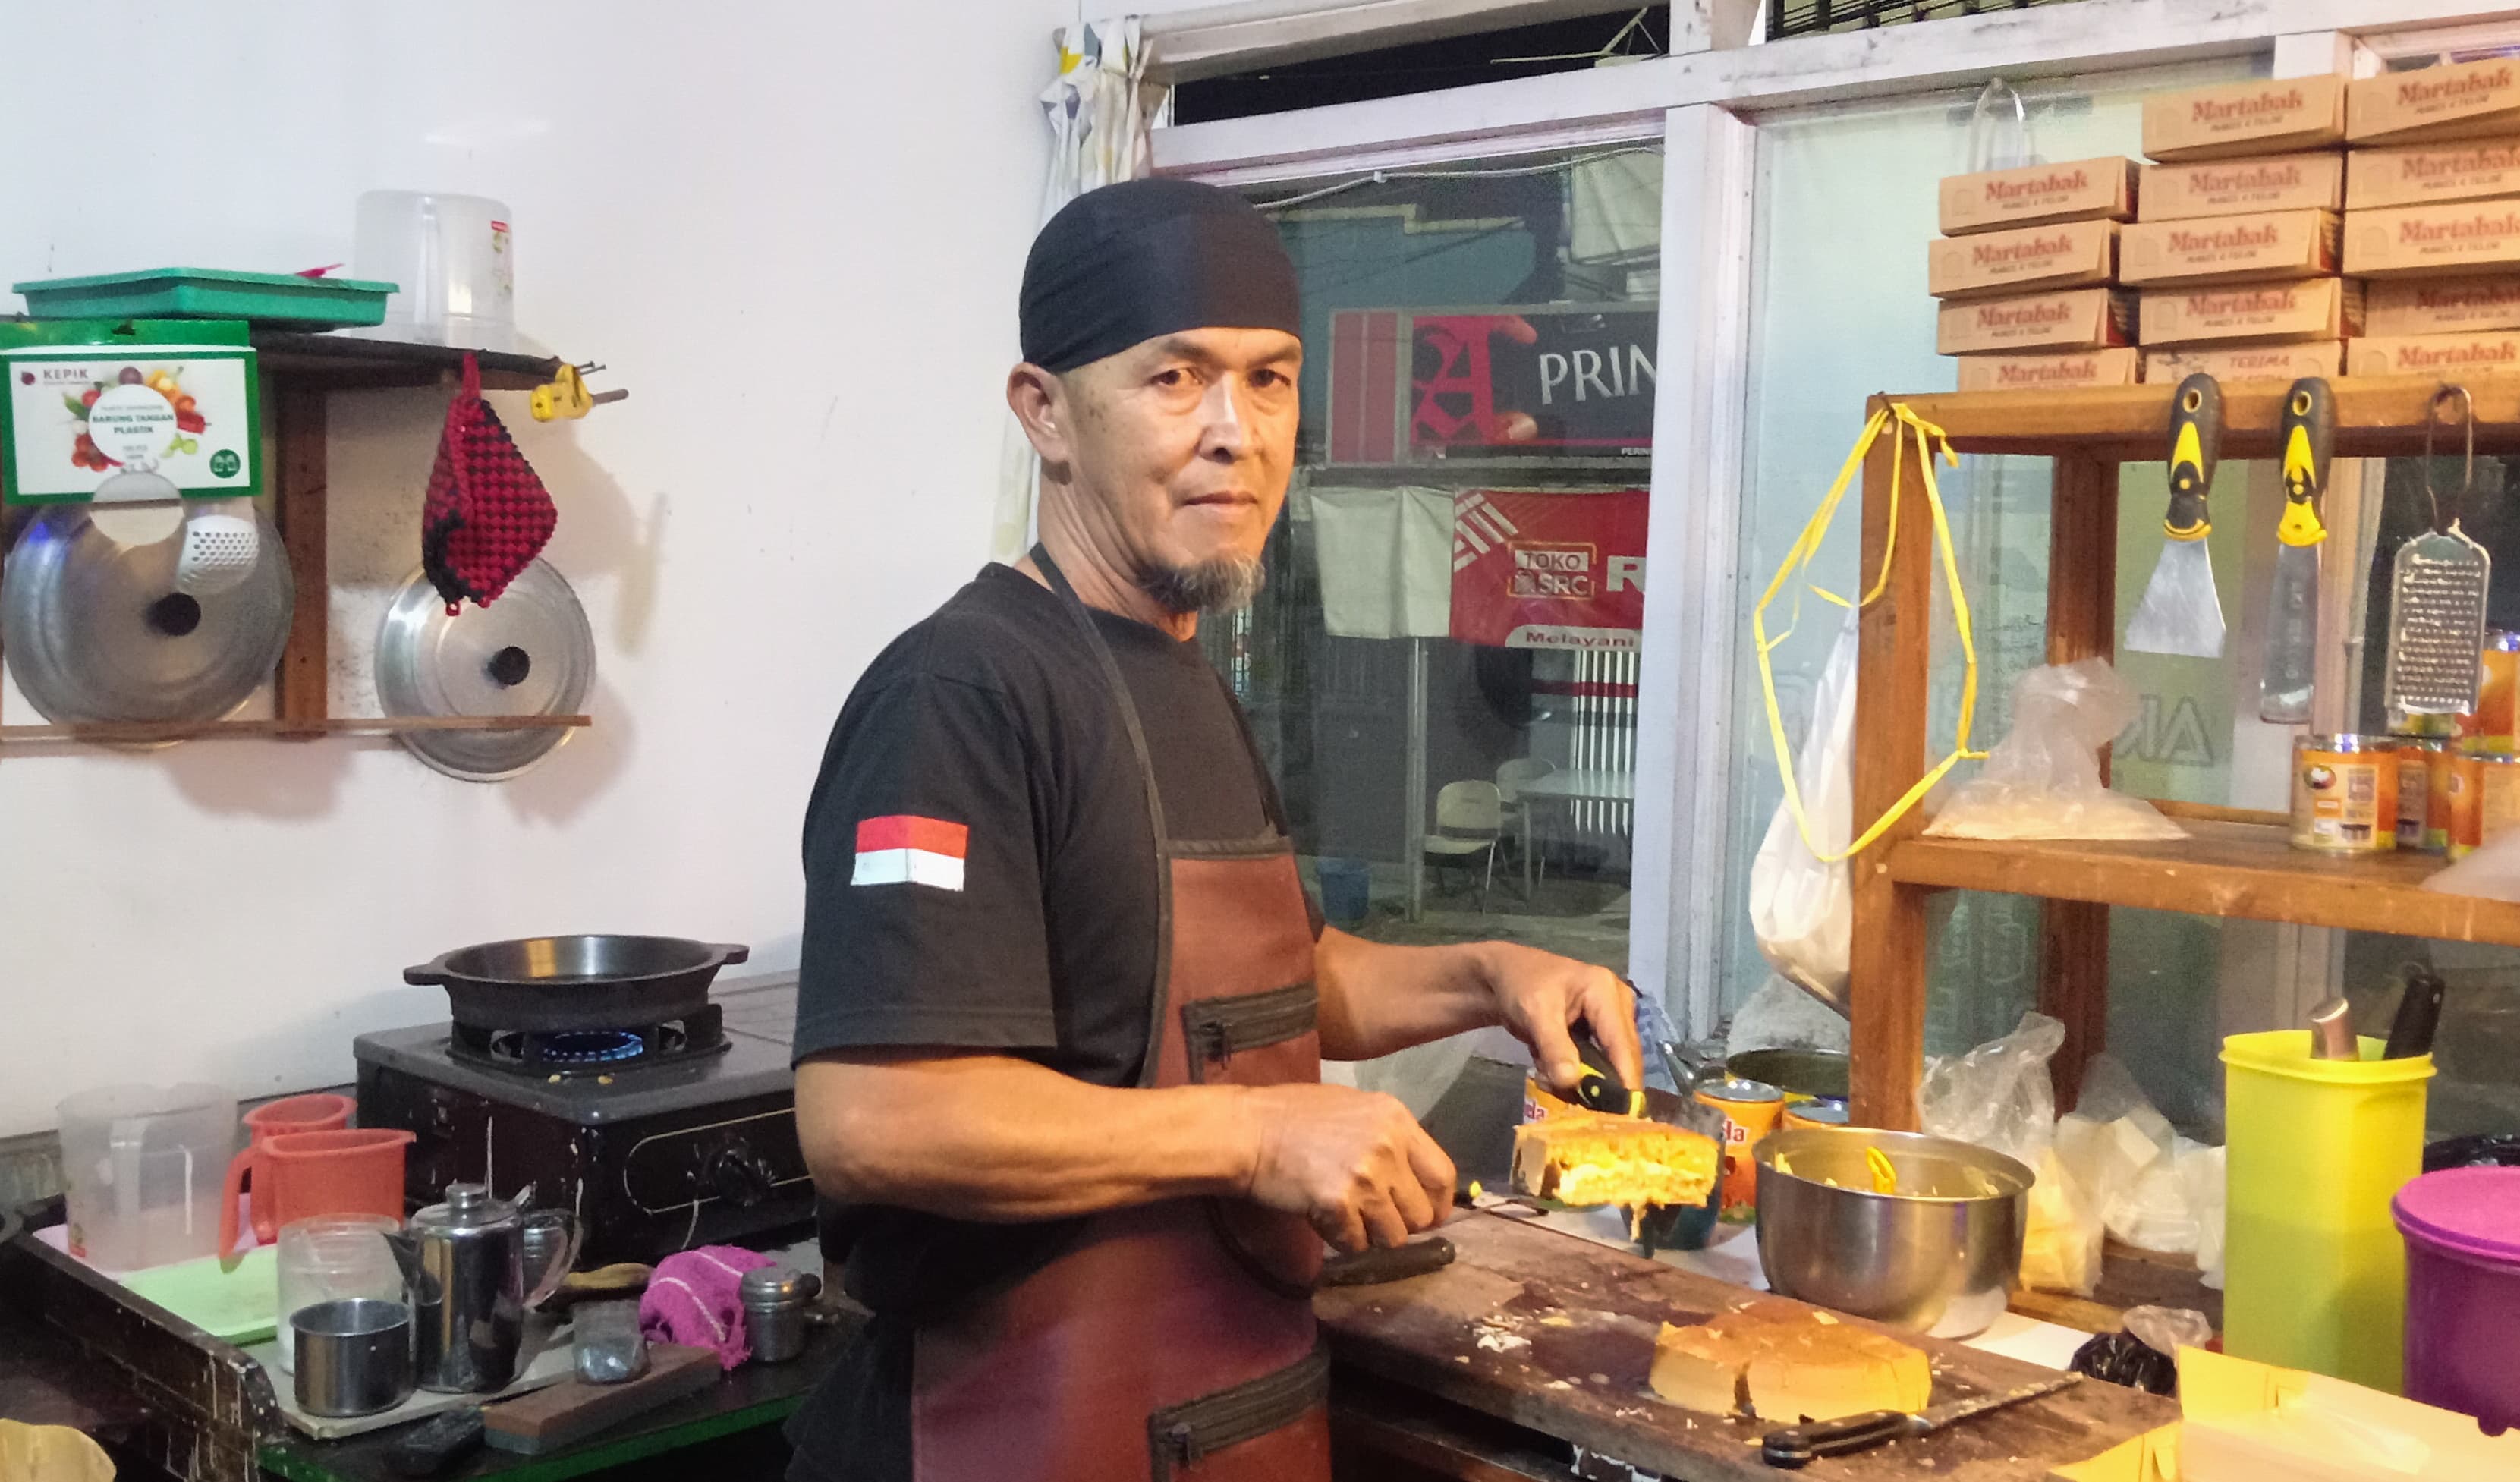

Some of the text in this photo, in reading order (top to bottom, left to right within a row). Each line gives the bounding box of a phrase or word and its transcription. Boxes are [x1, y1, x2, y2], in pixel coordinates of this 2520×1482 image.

[2397, 67, 2512, 105] Martabak
[2191, 90, 2303, 122] Martabak
[1986, 169, 2087, 201] Martabak
[2189, 166, 2301, 194] Martabak
[1973, 234, 2072, 266] Martabak
[2168, 225, 2279, 253] Martabak
[2186, 290, 2295, 316] Martabak
[2415, 281, 2520, 310] Martaba
[1977, 301, 2072, 328] Martabak
[2397, 340, 2515, 367] Martabak
[42, 369, 89, 379] KEPIK
[1997, 359, 2097, 383] Martabak
[1524, 552, 1581, 570] TOKO
[1538, 572, 1588, 596] SRC
[1526, 631, 1634, 647] Melayani
